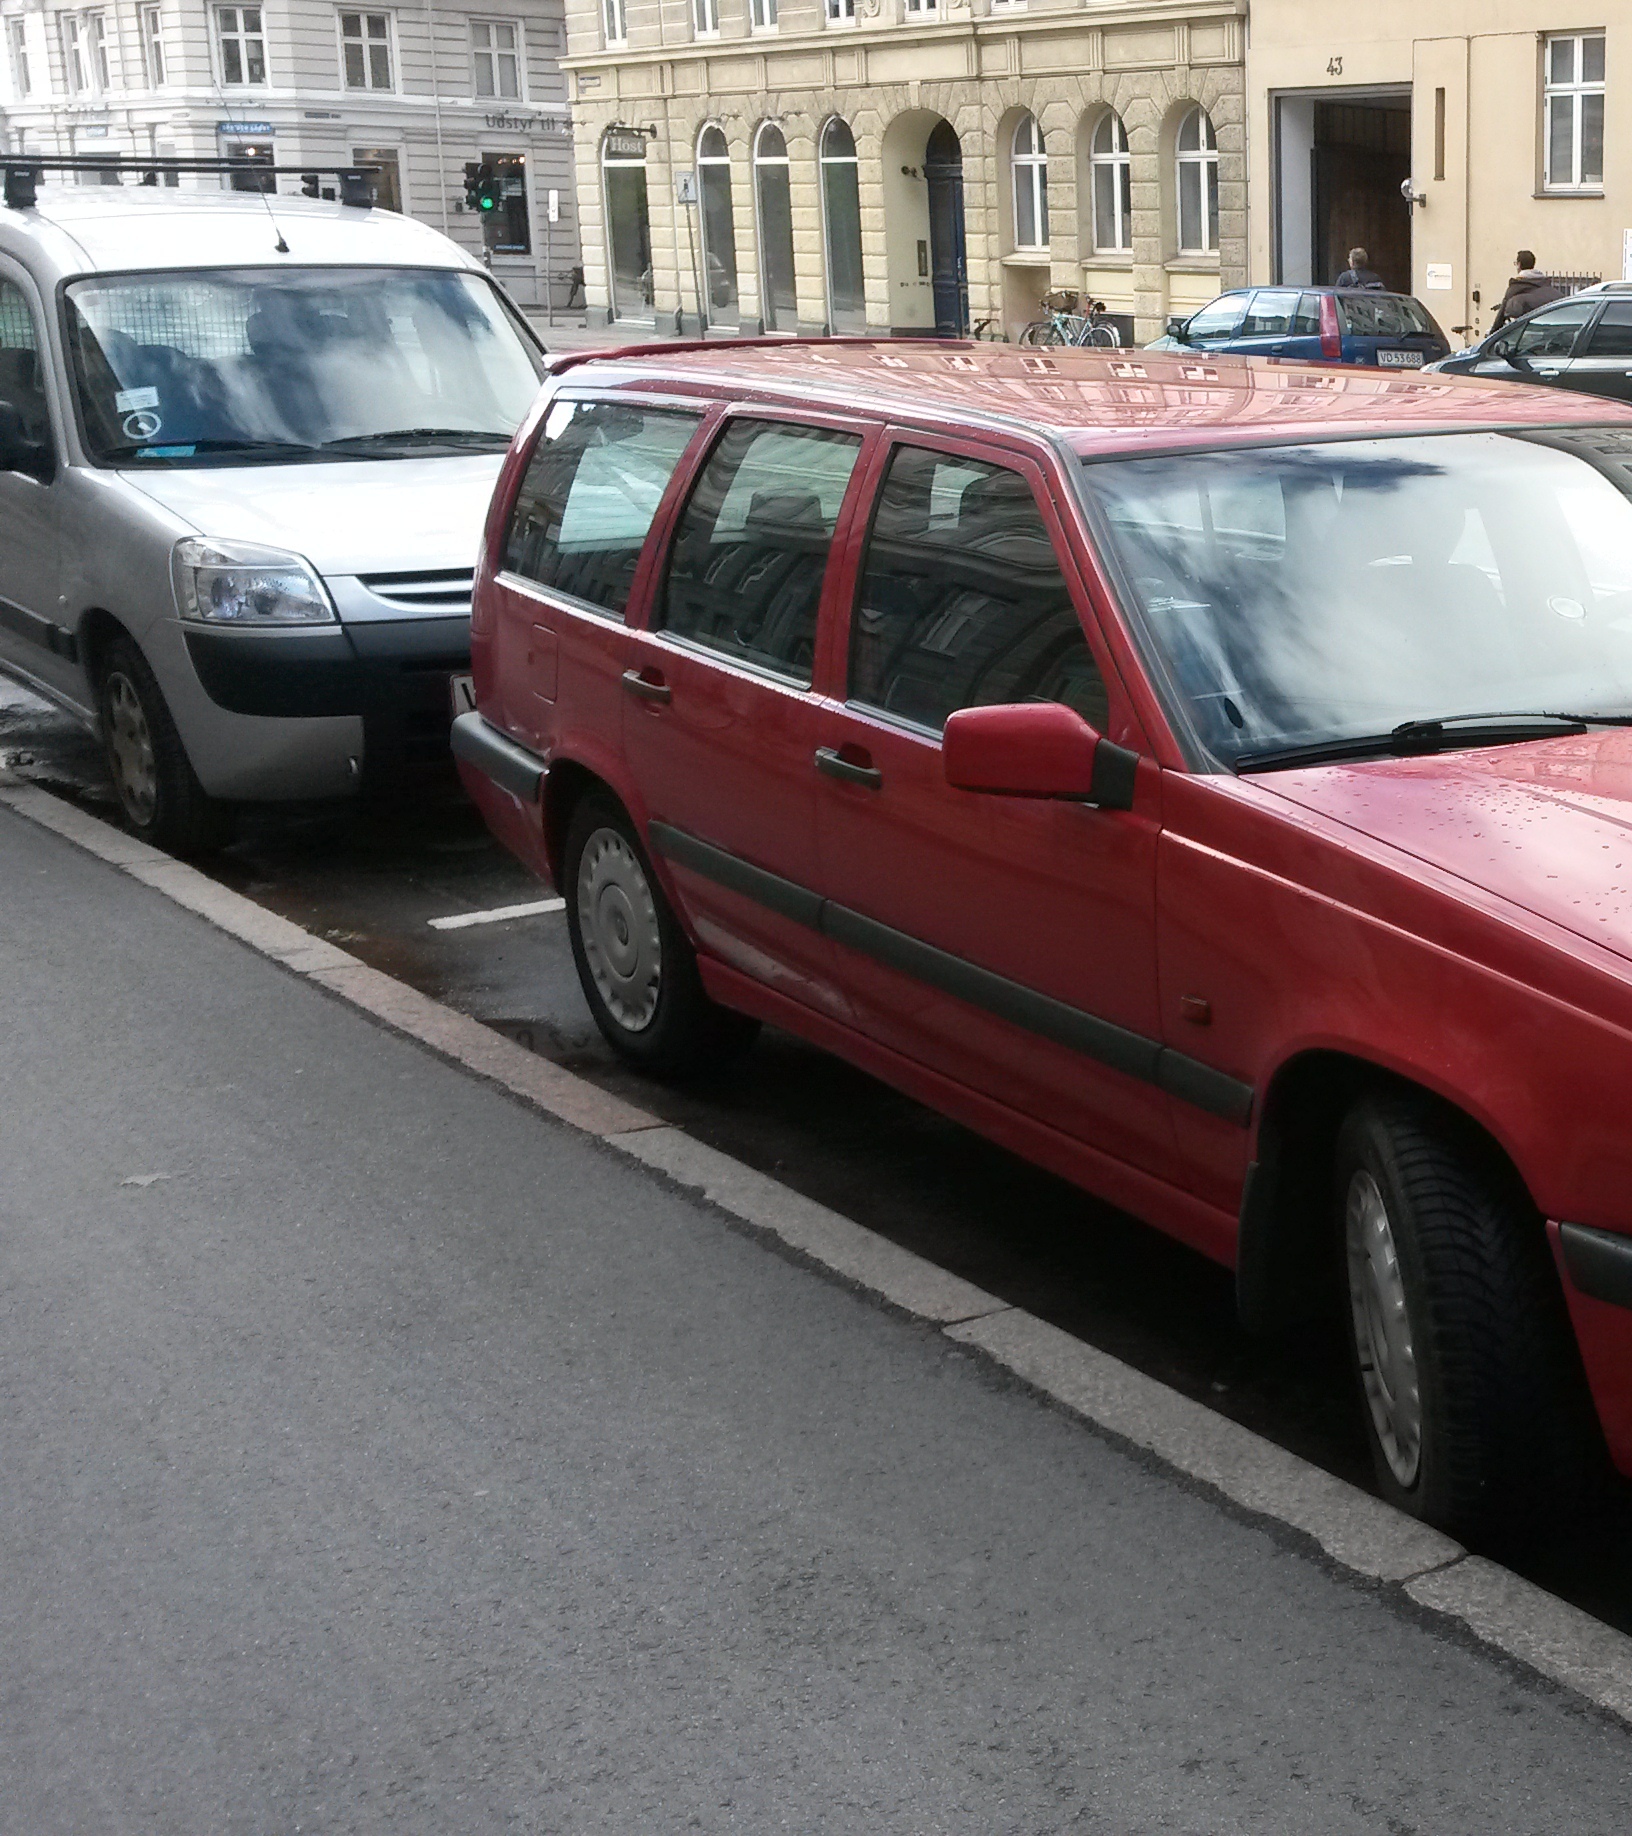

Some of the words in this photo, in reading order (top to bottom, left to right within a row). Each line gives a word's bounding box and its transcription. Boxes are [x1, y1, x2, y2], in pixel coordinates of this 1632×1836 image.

[1326, 56, 1342, 76] 43
[485, 114, 534, 133] Udstyr
[1380, 352, 1393, 363] VD
